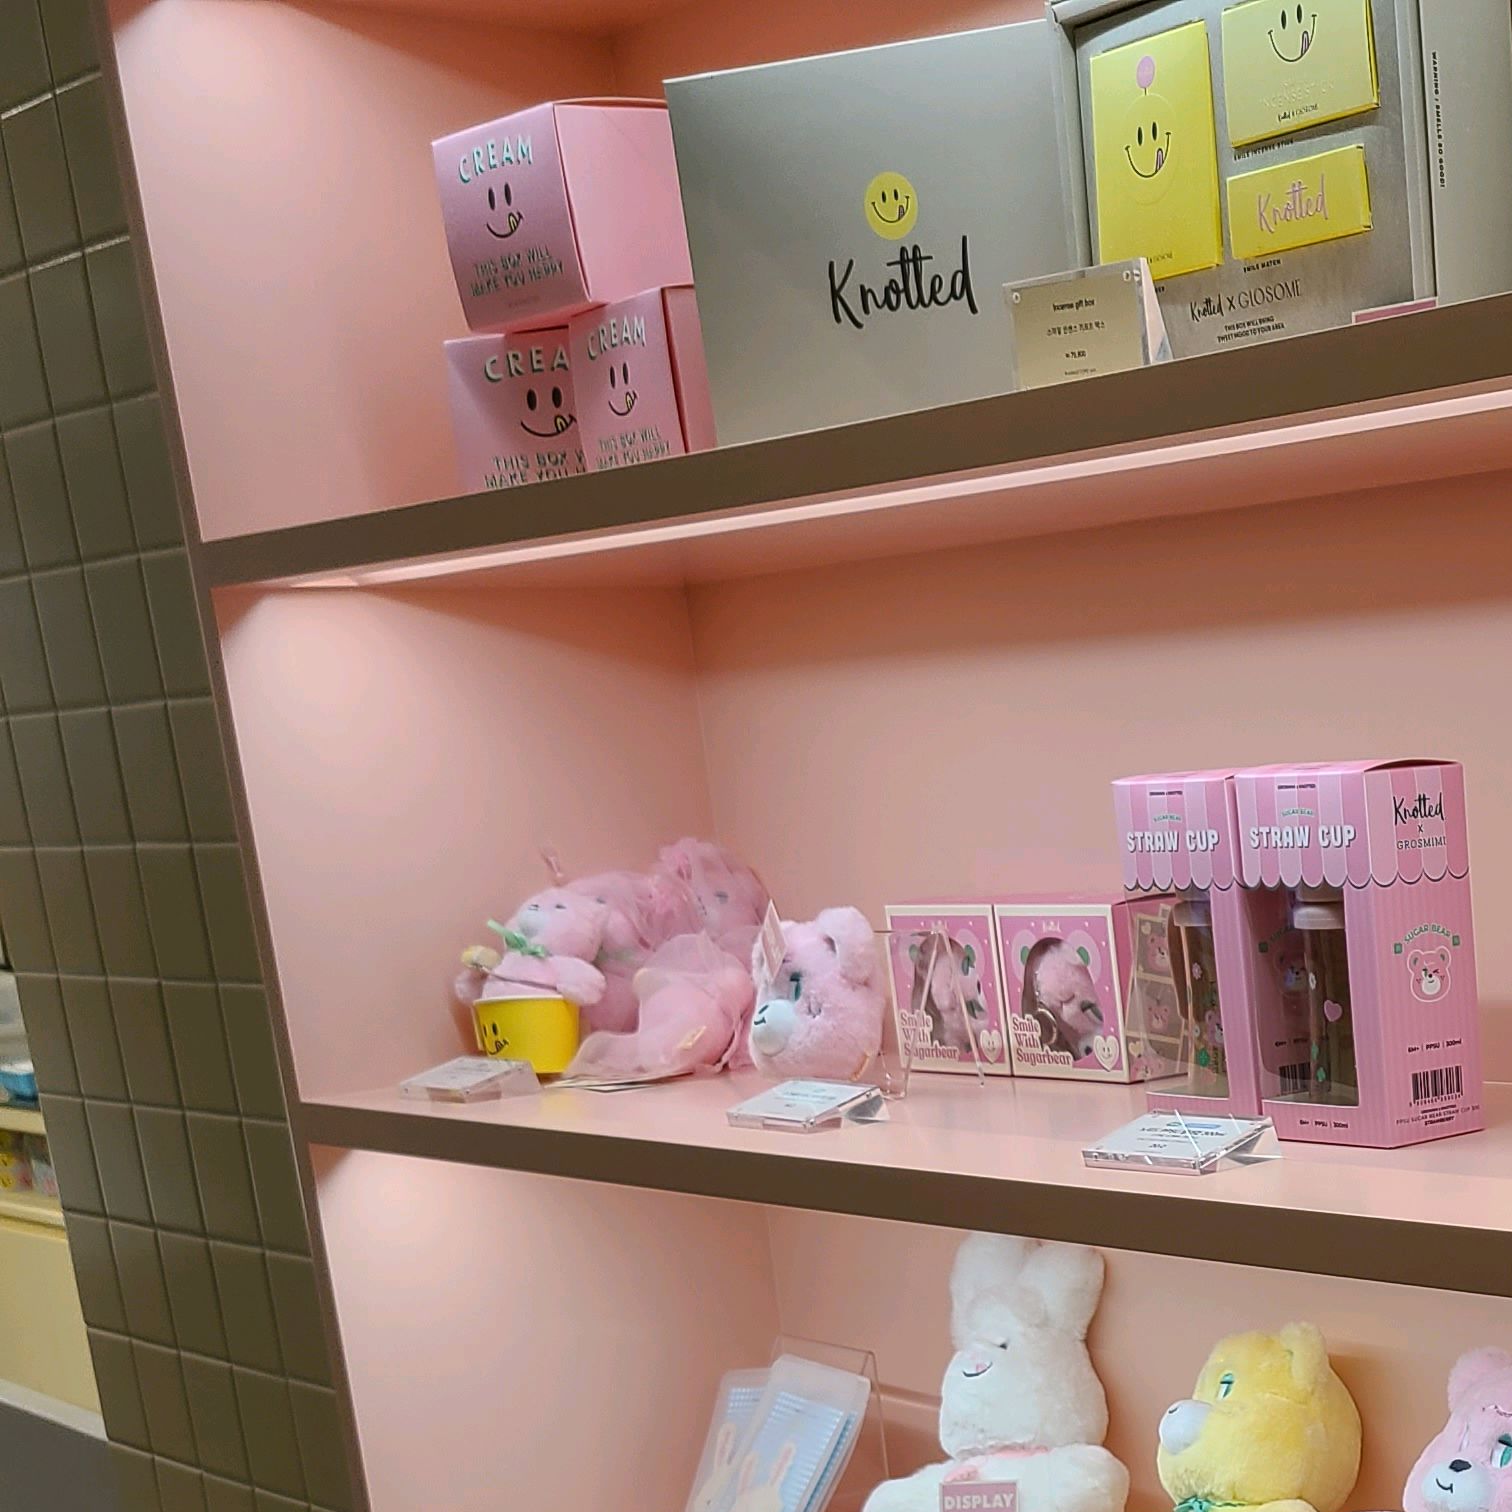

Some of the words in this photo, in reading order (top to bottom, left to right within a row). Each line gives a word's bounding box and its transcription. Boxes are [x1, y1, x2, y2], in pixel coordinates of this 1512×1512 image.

[458, 134, 534, 184] CREAM
[1256, 174, 1329, 235] Knotted
[828, 236, 978, 330] Knotted
[1190, 293, 1225, 323] Knotted
[587, 315, 646, 361] CREAM
[484, 345, 569, 383] CREA
[493, 455, 529, 471] THIS
[1392, 792, 1446, 826] Knotted
[1126, 830, 1180, 854] STRAW
[1185, 828, 1220, 853] CUP
[1249, 825, 1311, 850] STRAW
[1317, 824, 1357, 849] CUP
[1396, 836, 1447, 850] GROSMIMI
[1404, 924, 1430, 944] SUGAR
[1430, 924, 1451, 939] BEAR
[1012, 1016, 1040, 1034] Smile
[1013, 1033, 1040, 1050] With
[1016, 1048, 1073, 1067] Sugarbear
[944, 1493, 1015, 1511] DISPLAY
